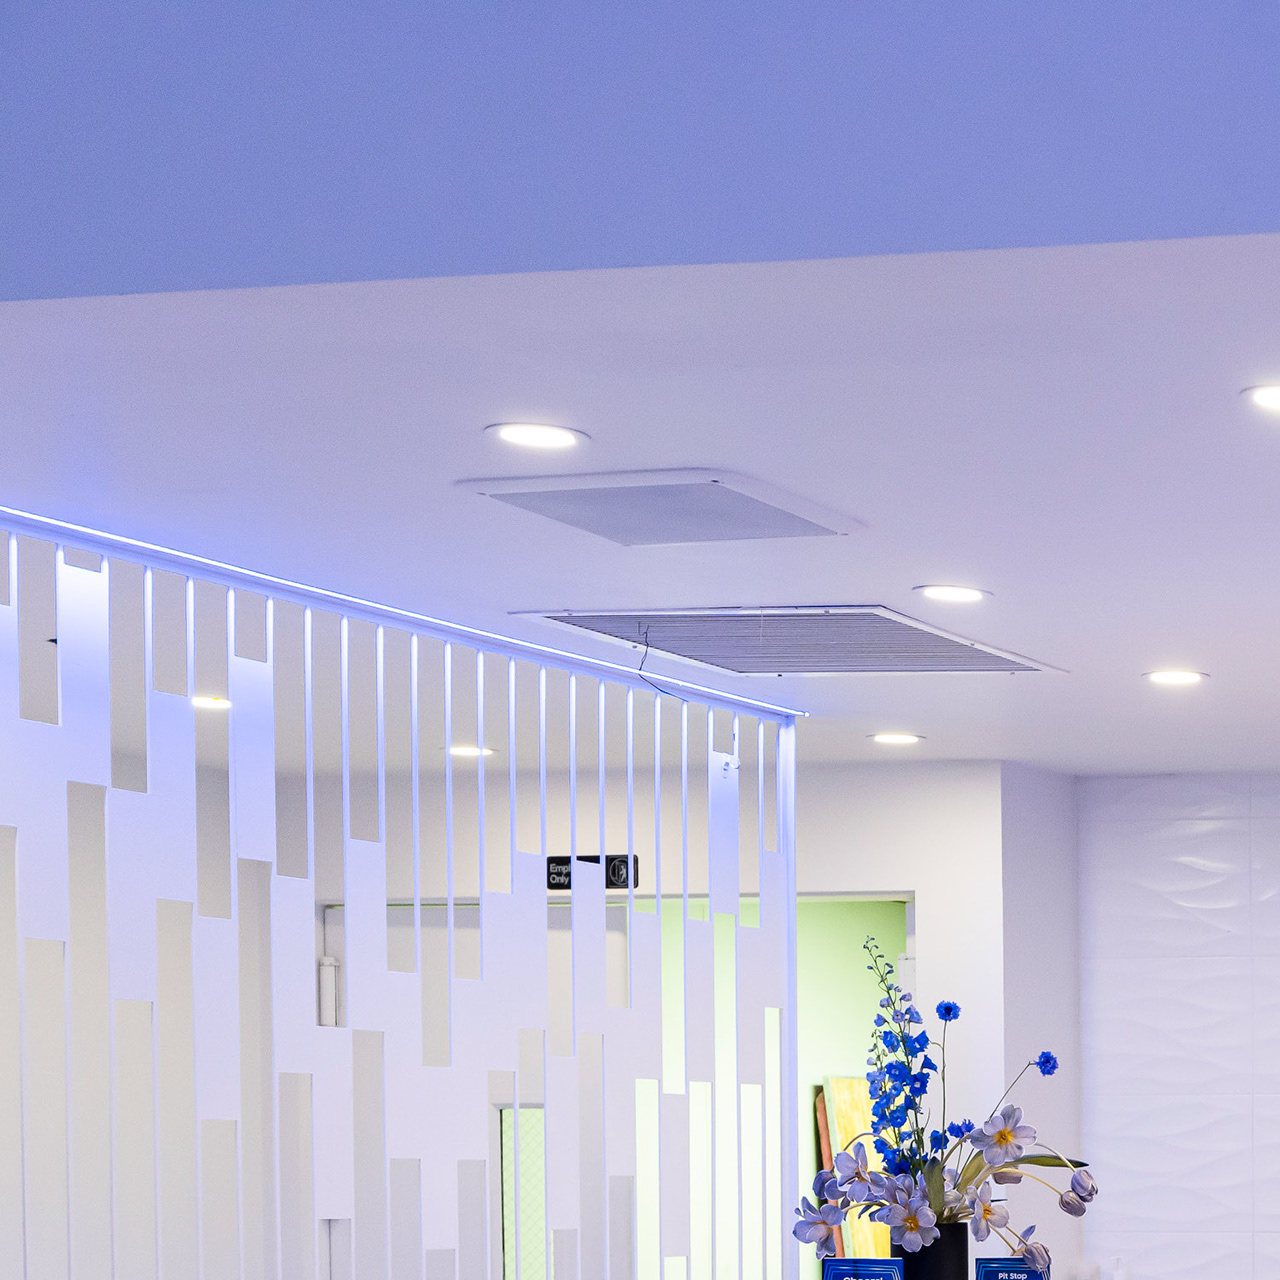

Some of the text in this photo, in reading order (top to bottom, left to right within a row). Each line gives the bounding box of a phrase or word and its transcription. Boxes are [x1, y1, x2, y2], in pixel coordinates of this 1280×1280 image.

[549, 874, 569, 885] Only
[998, 1272, 1028, 1280] Pit Stop
